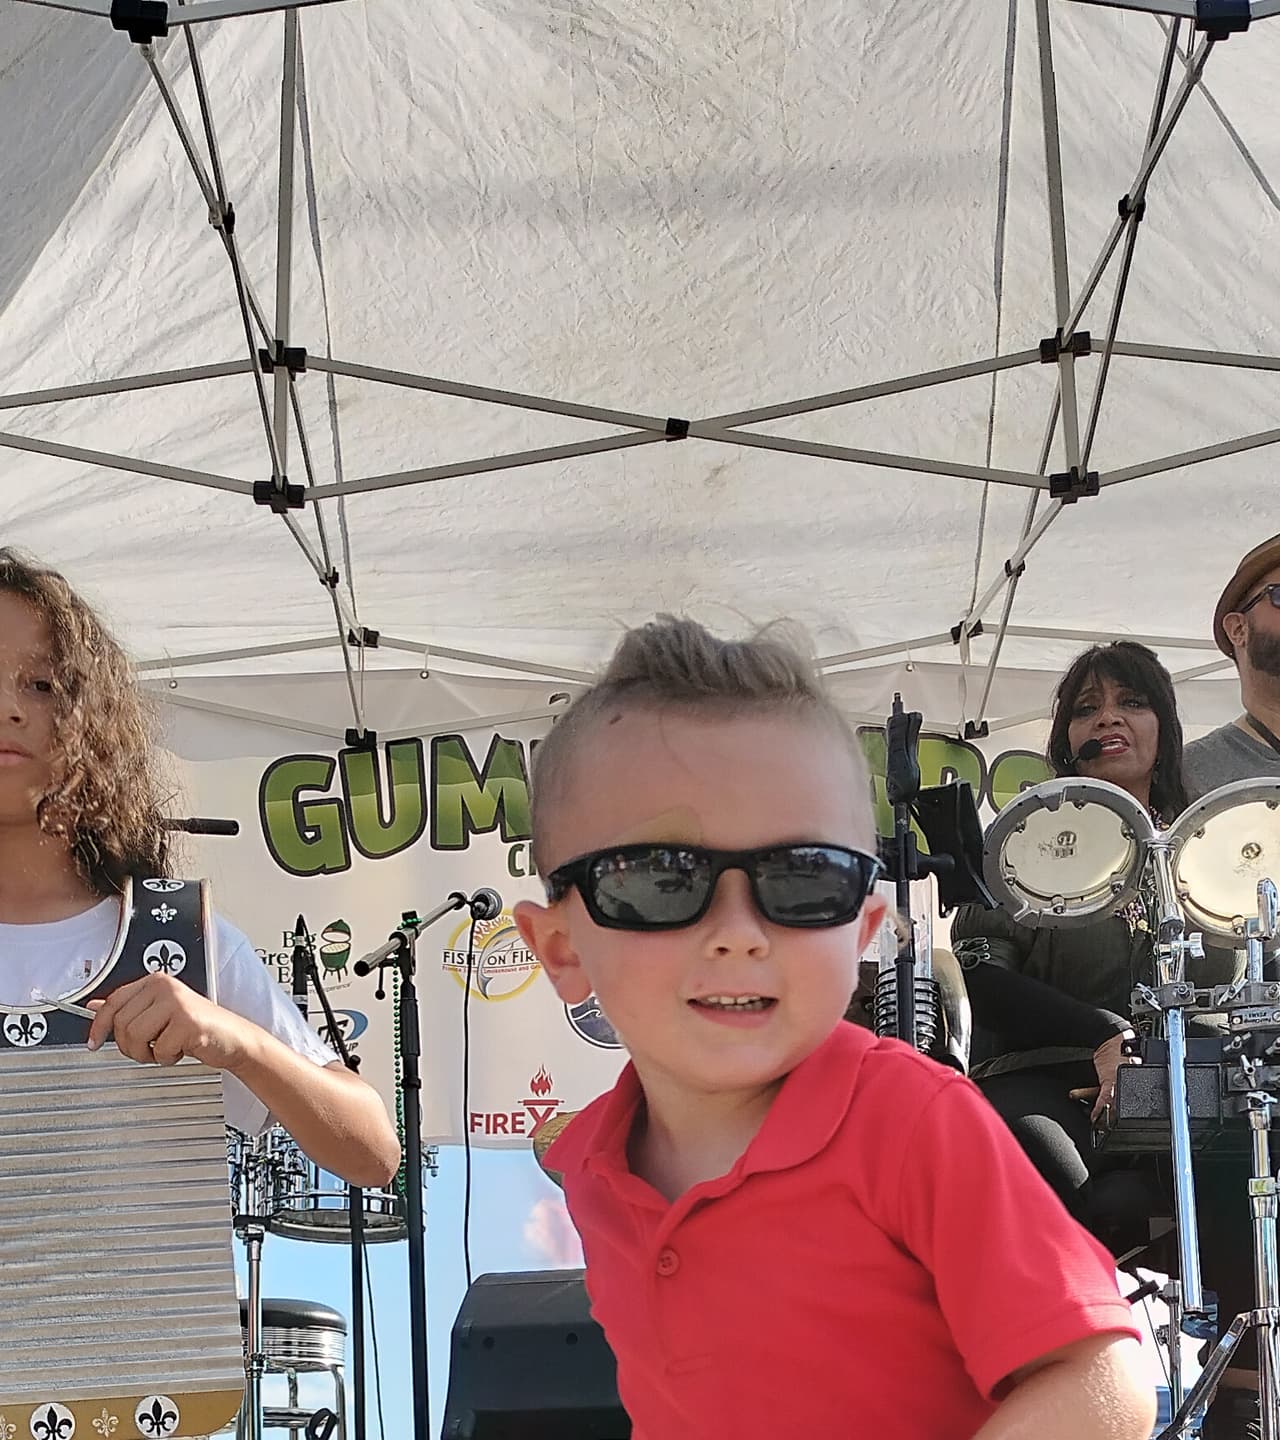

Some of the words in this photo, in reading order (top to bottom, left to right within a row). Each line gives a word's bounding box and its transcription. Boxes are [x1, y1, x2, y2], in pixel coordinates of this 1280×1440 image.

[259, 734, 546, 877] GUM
[443, 951, 476, 966] FISH
[487, 955, 506, 966] ON
[512, 951, 540, 964] FIR
